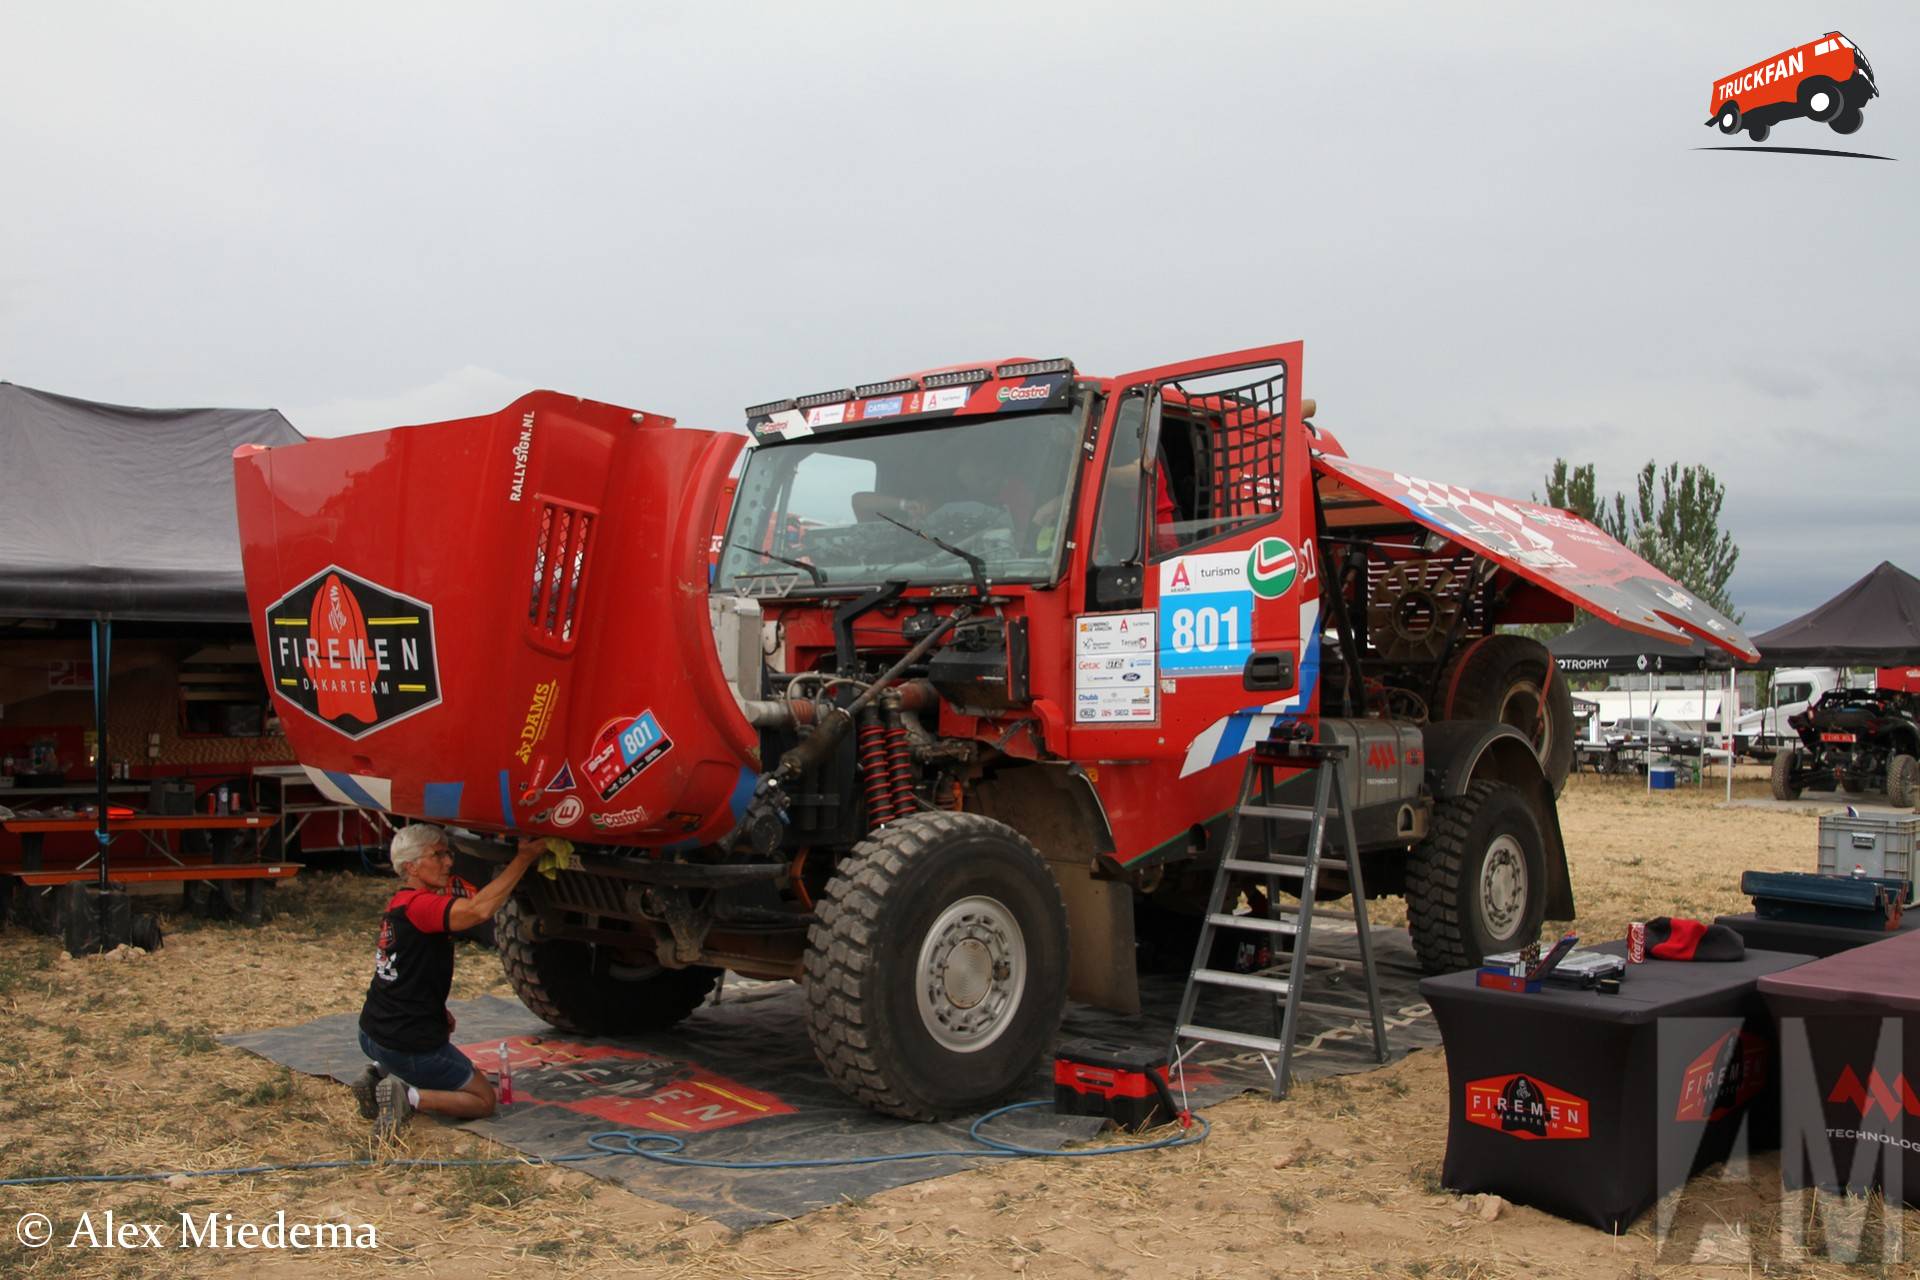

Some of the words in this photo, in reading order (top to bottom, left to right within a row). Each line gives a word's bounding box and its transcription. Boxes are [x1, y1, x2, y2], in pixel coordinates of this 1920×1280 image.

[1009, 383, 1051, 401] Castrol
[509, 410, 536, 503] RALLYSIGN.NL
[1200, 566, 1241, 579] turismo
[1171, 605, 1239, 654] 801
[279, 636, 420, 672] FIREMEN
[303, 677, 390, 695] DAKARTEAM
[624, 719, 654, 755] 801
[603, 805, 648, 826] Castrol
[1473, 1094, 1580, 1125] FIREMEN
[1825, 1128, 1920, 1153] TECHNOLOG
